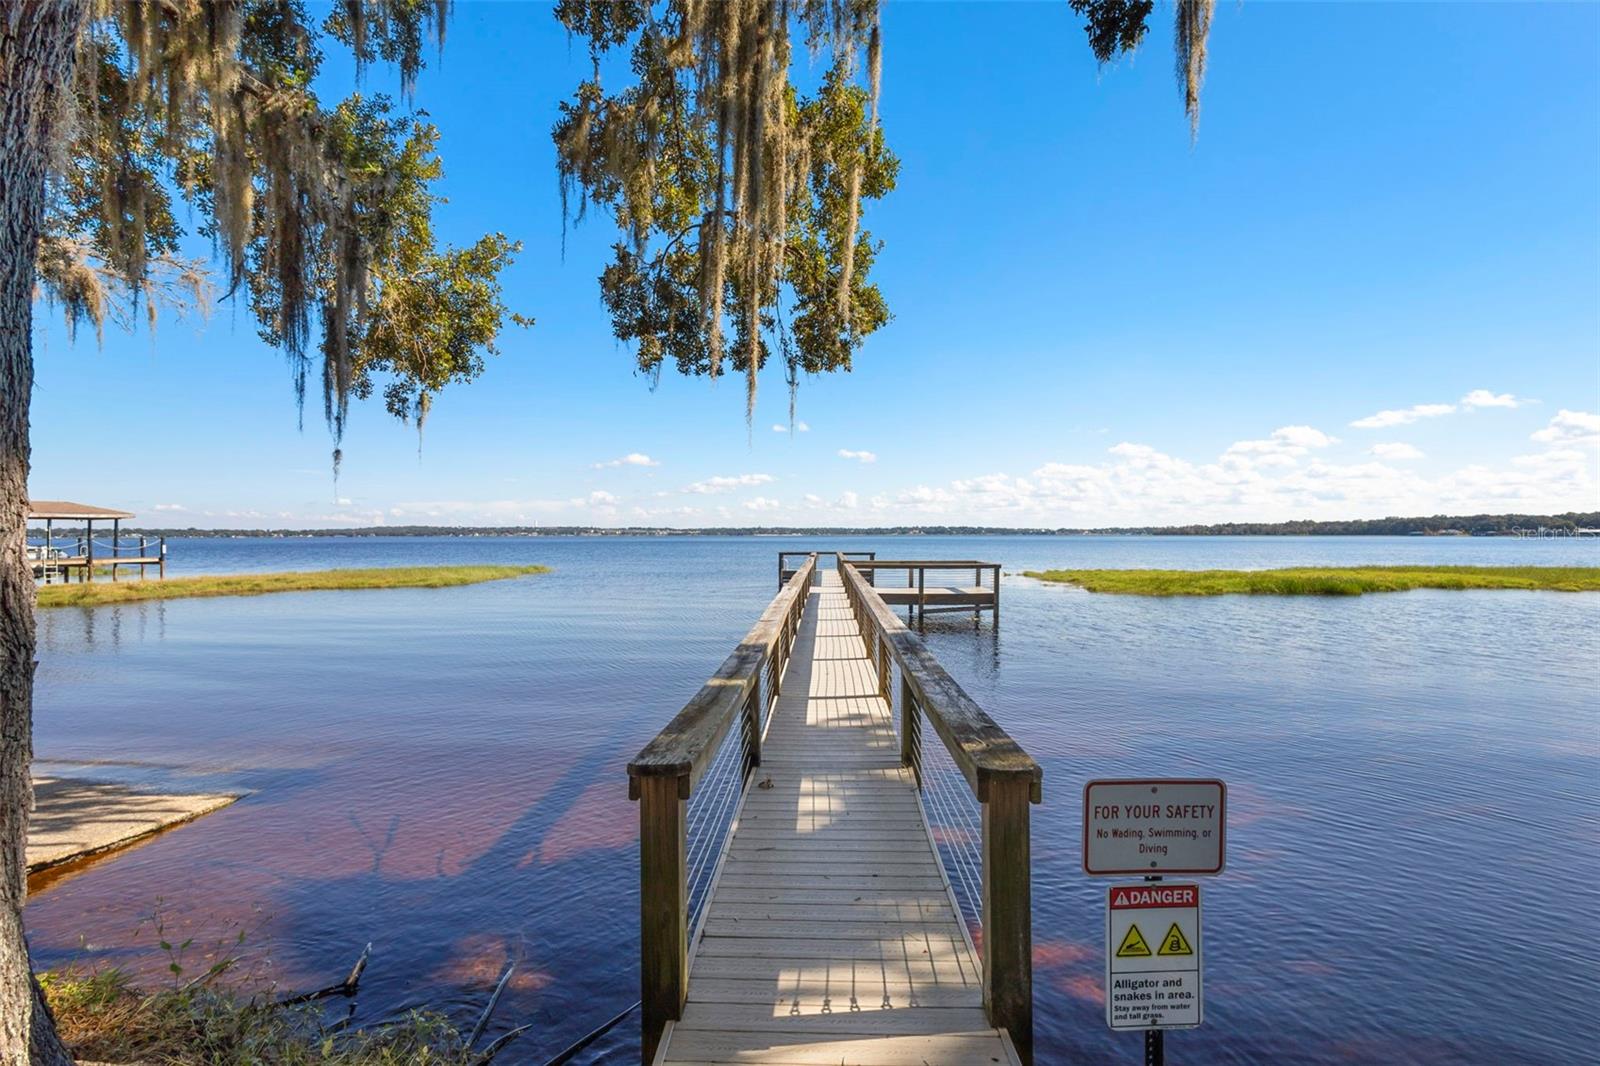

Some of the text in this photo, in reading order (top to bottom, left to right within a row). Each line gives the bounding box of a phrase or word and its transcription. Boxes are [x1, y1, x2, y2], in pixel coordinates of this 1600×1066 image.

[1094, 805, 1215, 819] FOR YOUR SAFETY
[1096, 828, 1108, 838] No
[1202, 829, 1212, 838] or
[1139, 843, 1168, 856] Diving
[1130, 890, 1194, 905] DANGER
[1114, 978, 1182, 990] Alligator and
[1114, 990, 1195, 1001] snakes in area.
